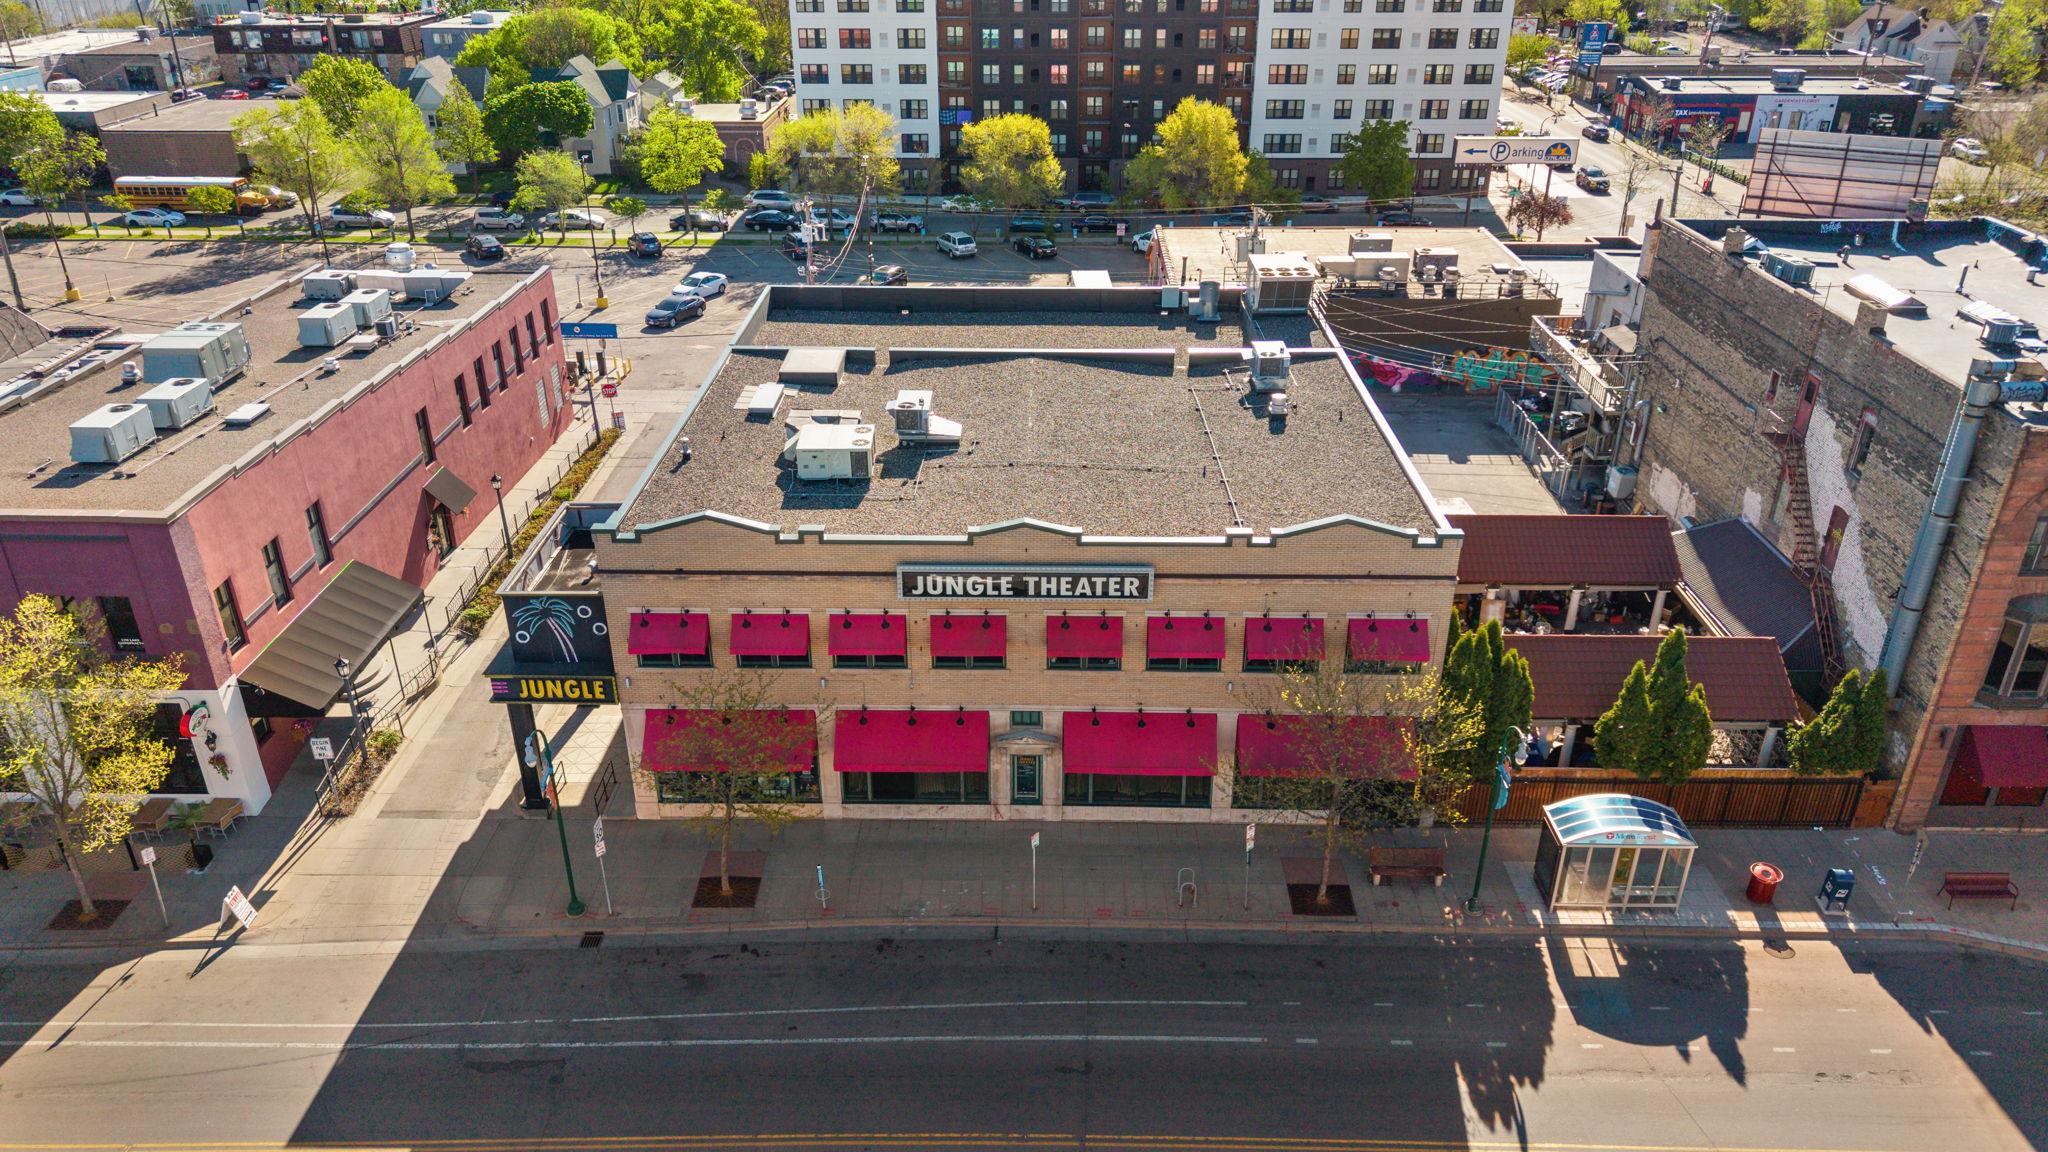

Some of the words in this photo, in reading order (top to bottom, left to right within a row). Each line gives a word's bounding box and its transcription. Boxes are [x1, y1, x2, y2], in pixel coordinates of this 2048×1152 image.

[1495, 144, 1544, 160] Parking
[912, 574, 1014, 596] JUNGLE
[1023, 576, 1141, 597] THEATER
[520, 679, 606, 699] JUNGLE
